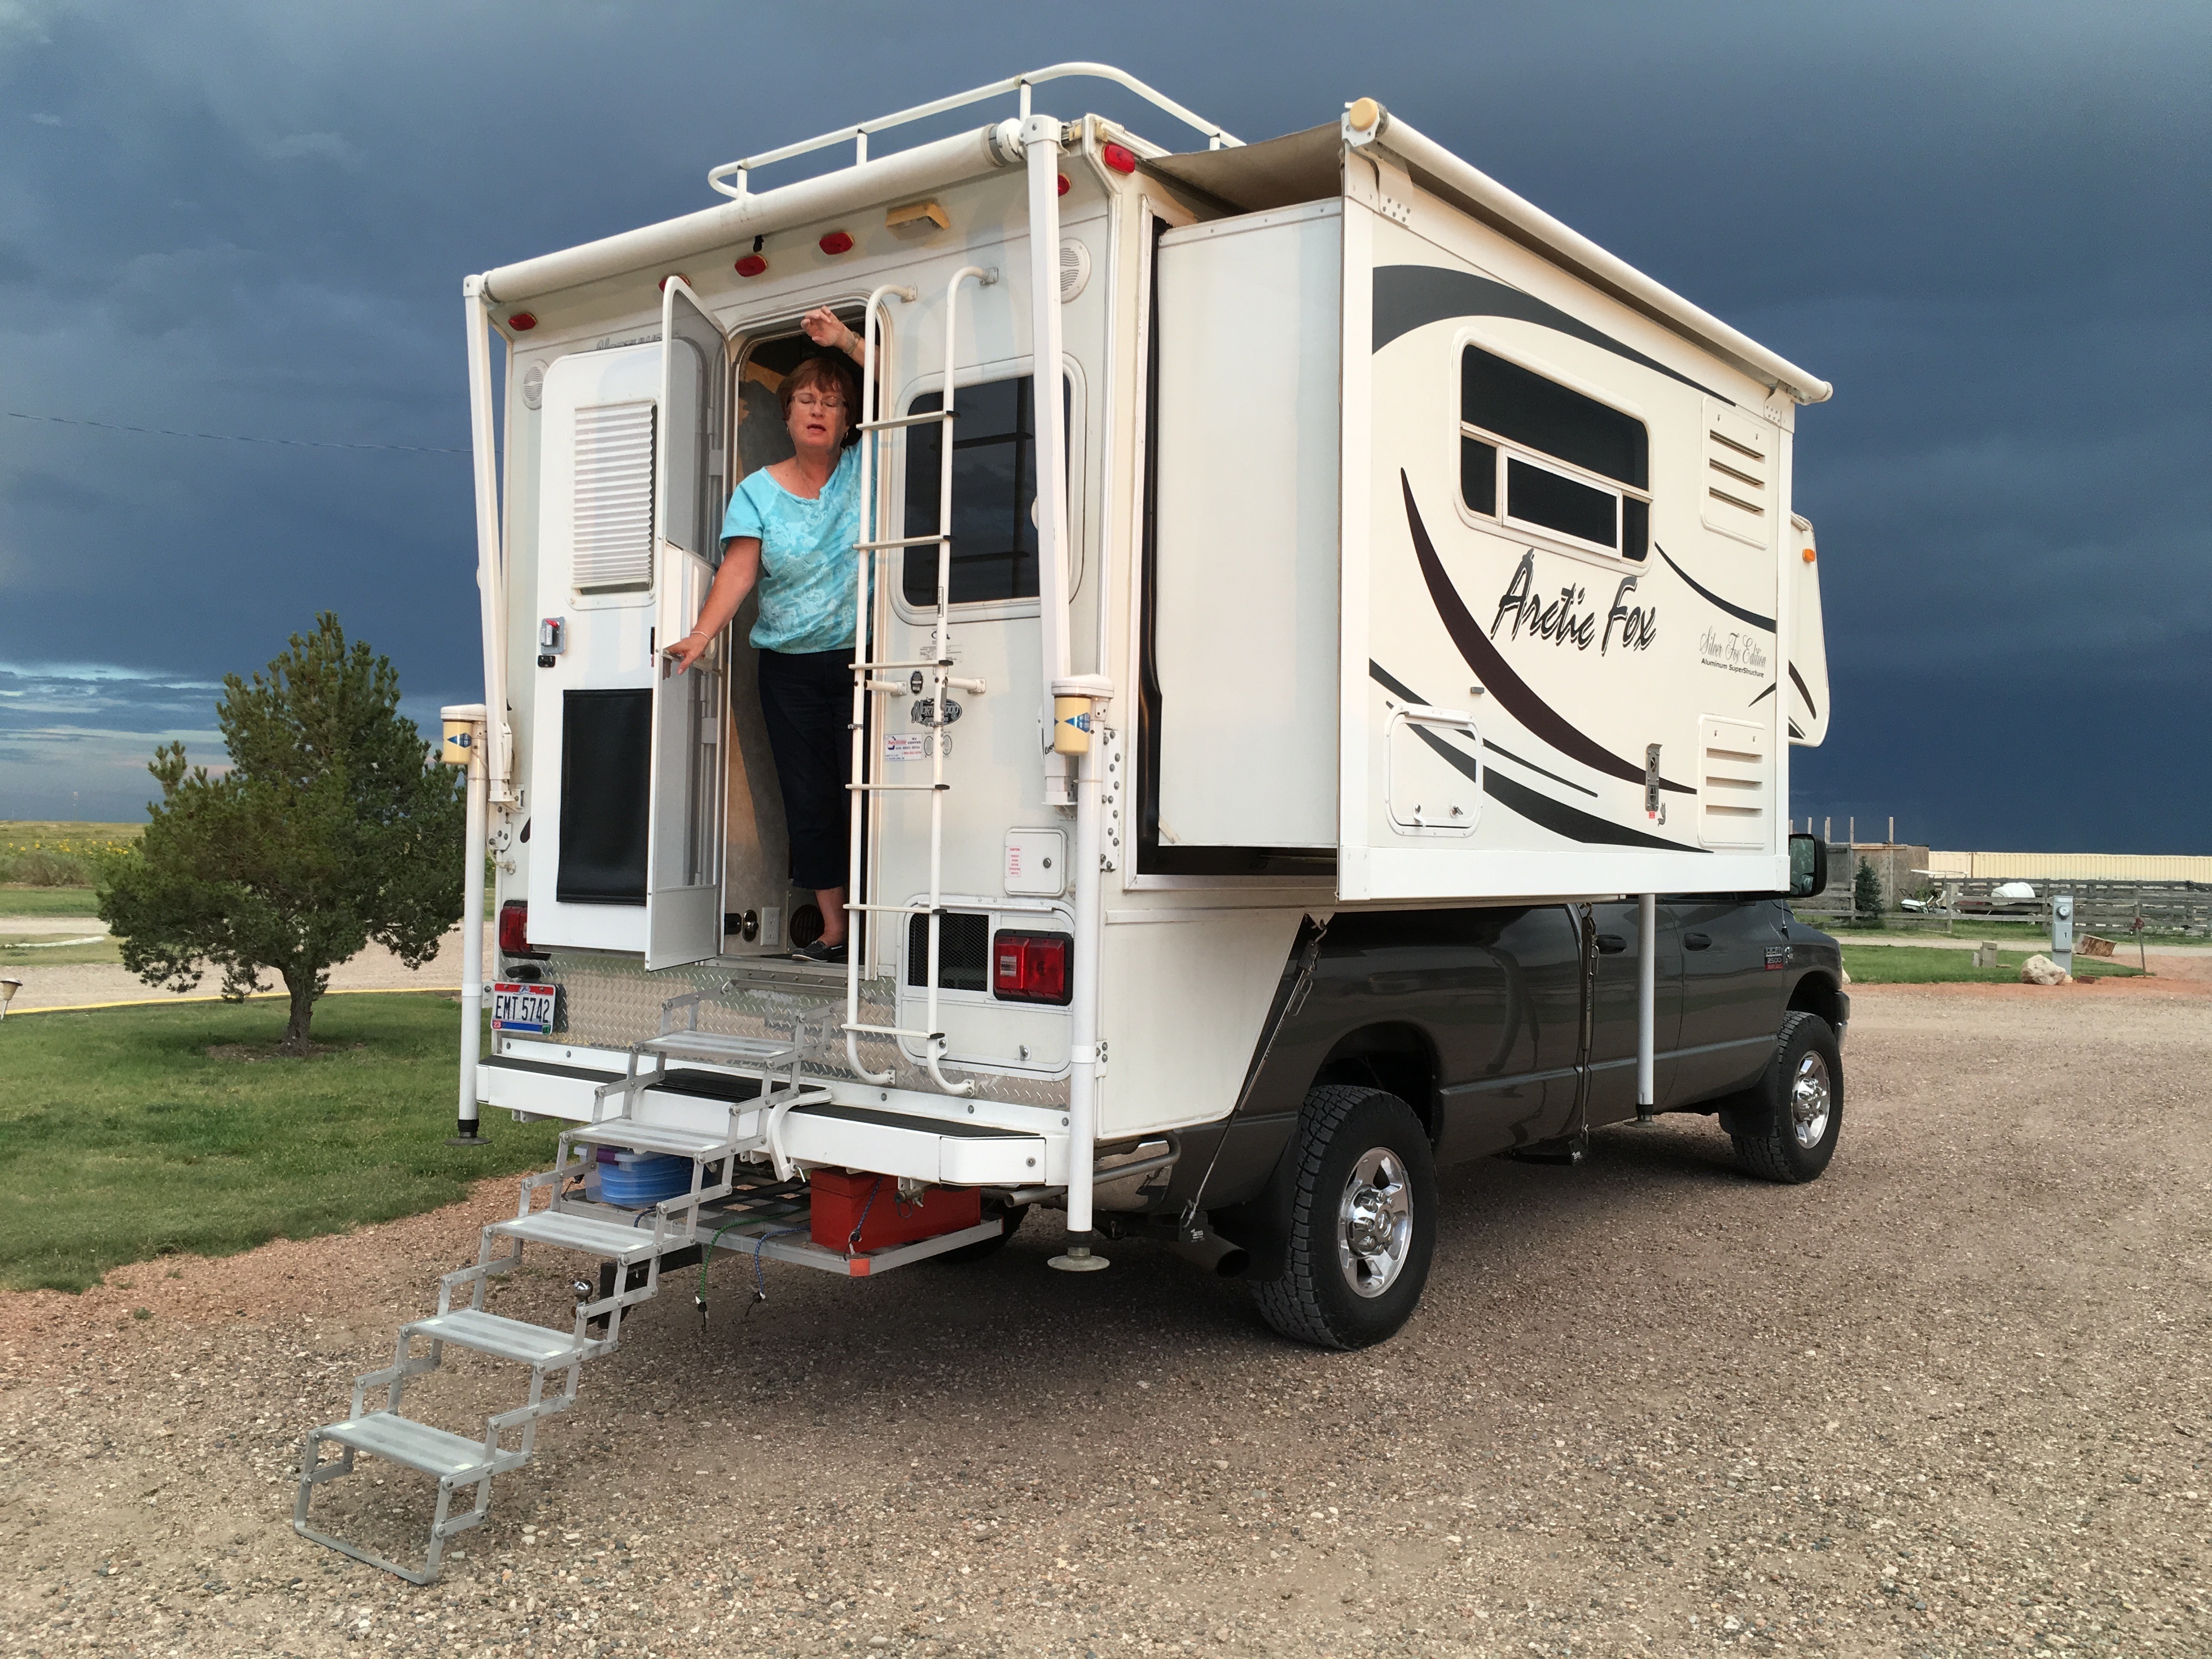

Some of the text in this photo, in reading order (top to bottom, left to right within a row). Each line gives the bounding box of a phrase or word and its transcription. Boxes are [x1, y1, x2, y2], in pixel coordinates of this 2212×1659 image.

[1491, 548, 1656, 657] Arctic Fox
[1699, 626, 1767, 668] Silver Fox Edition
[1701, 658, 1764, 678] Aluminum SuperStructure
[495, 995, 550, 1023] EMT 5742
